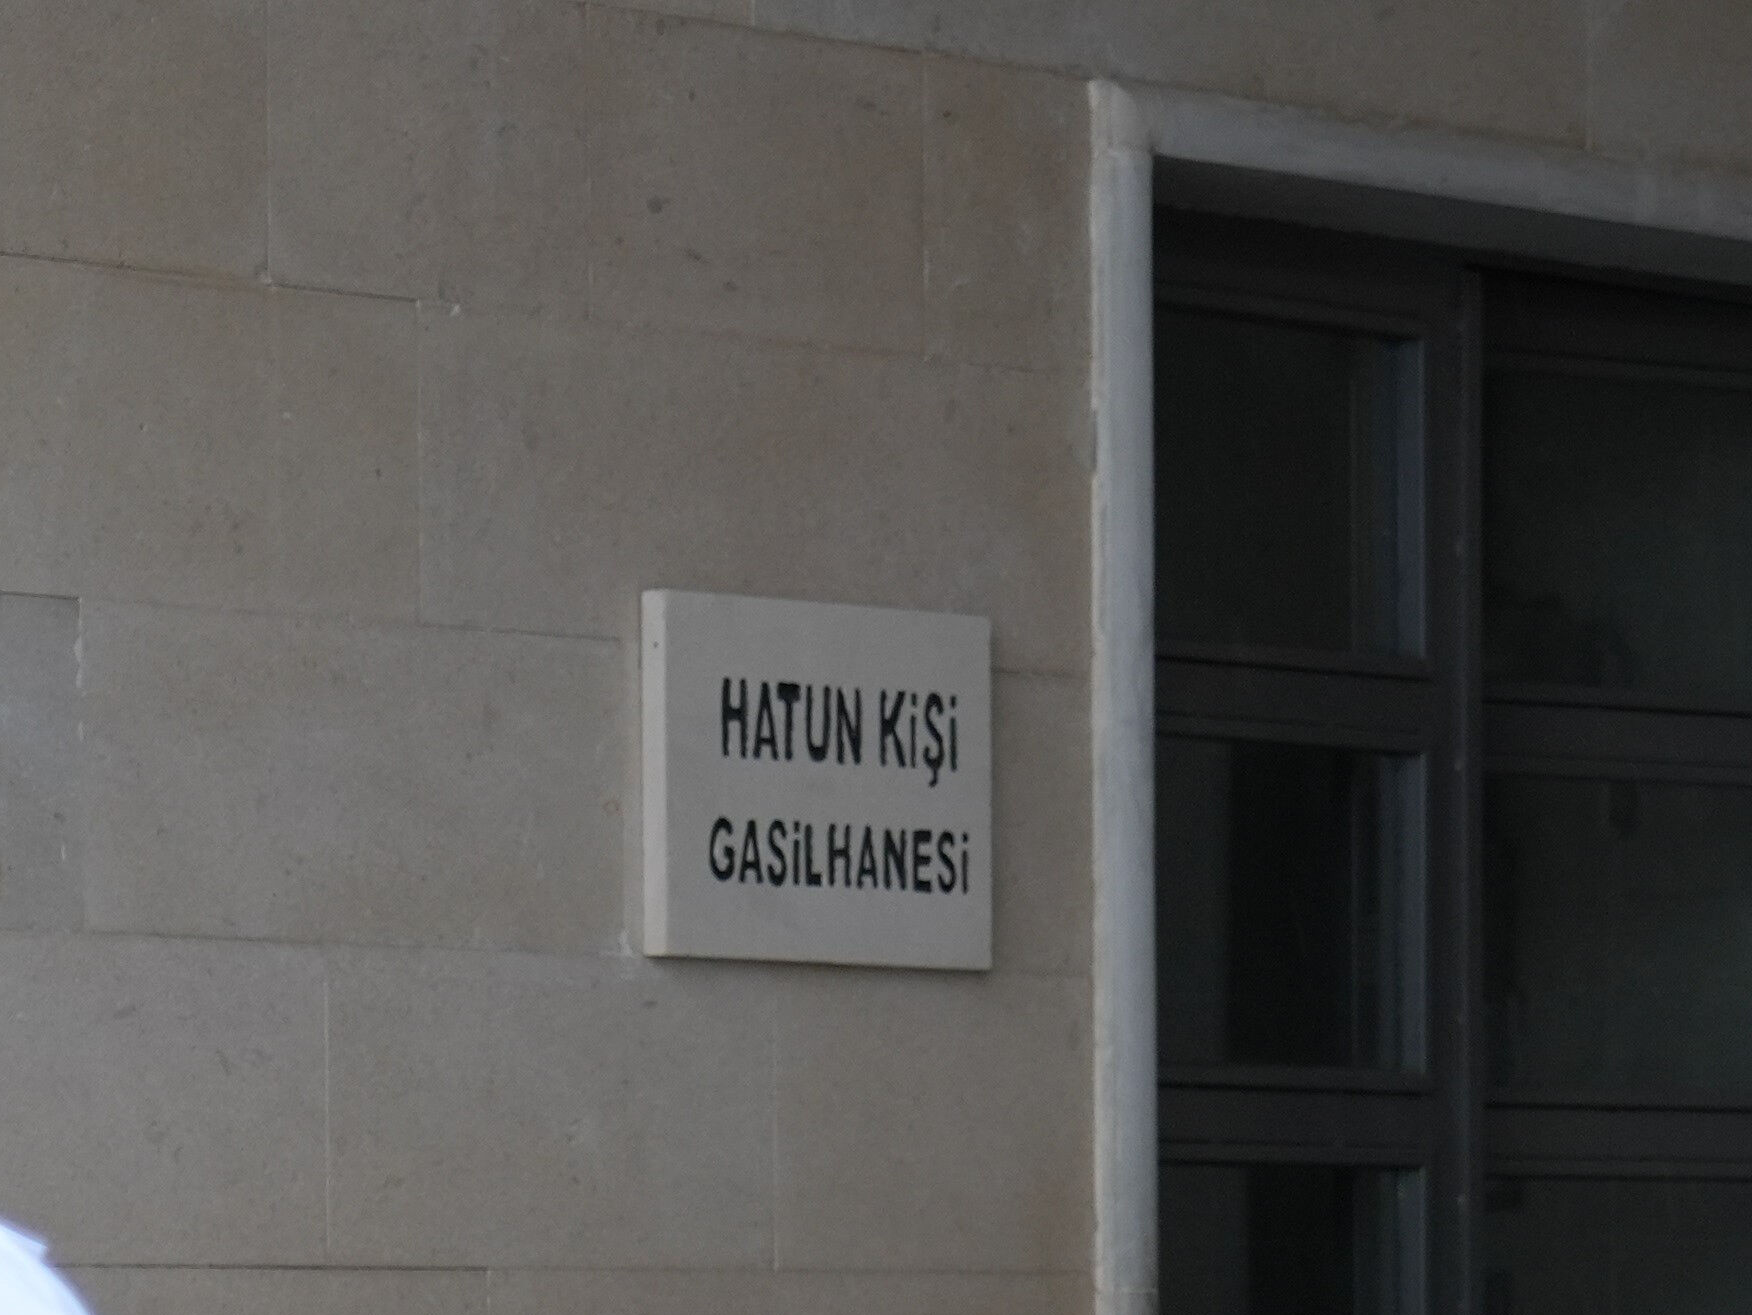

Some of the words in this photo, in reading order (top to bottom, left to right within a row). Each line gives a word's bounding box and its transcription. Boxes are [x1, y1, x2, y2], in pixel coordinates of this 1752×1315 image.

[720, 677, 863, 766] HATUN
[879, 689, 959, 788] KİŞİ
[708, 816, 970, 894] GASİLHANESİ
